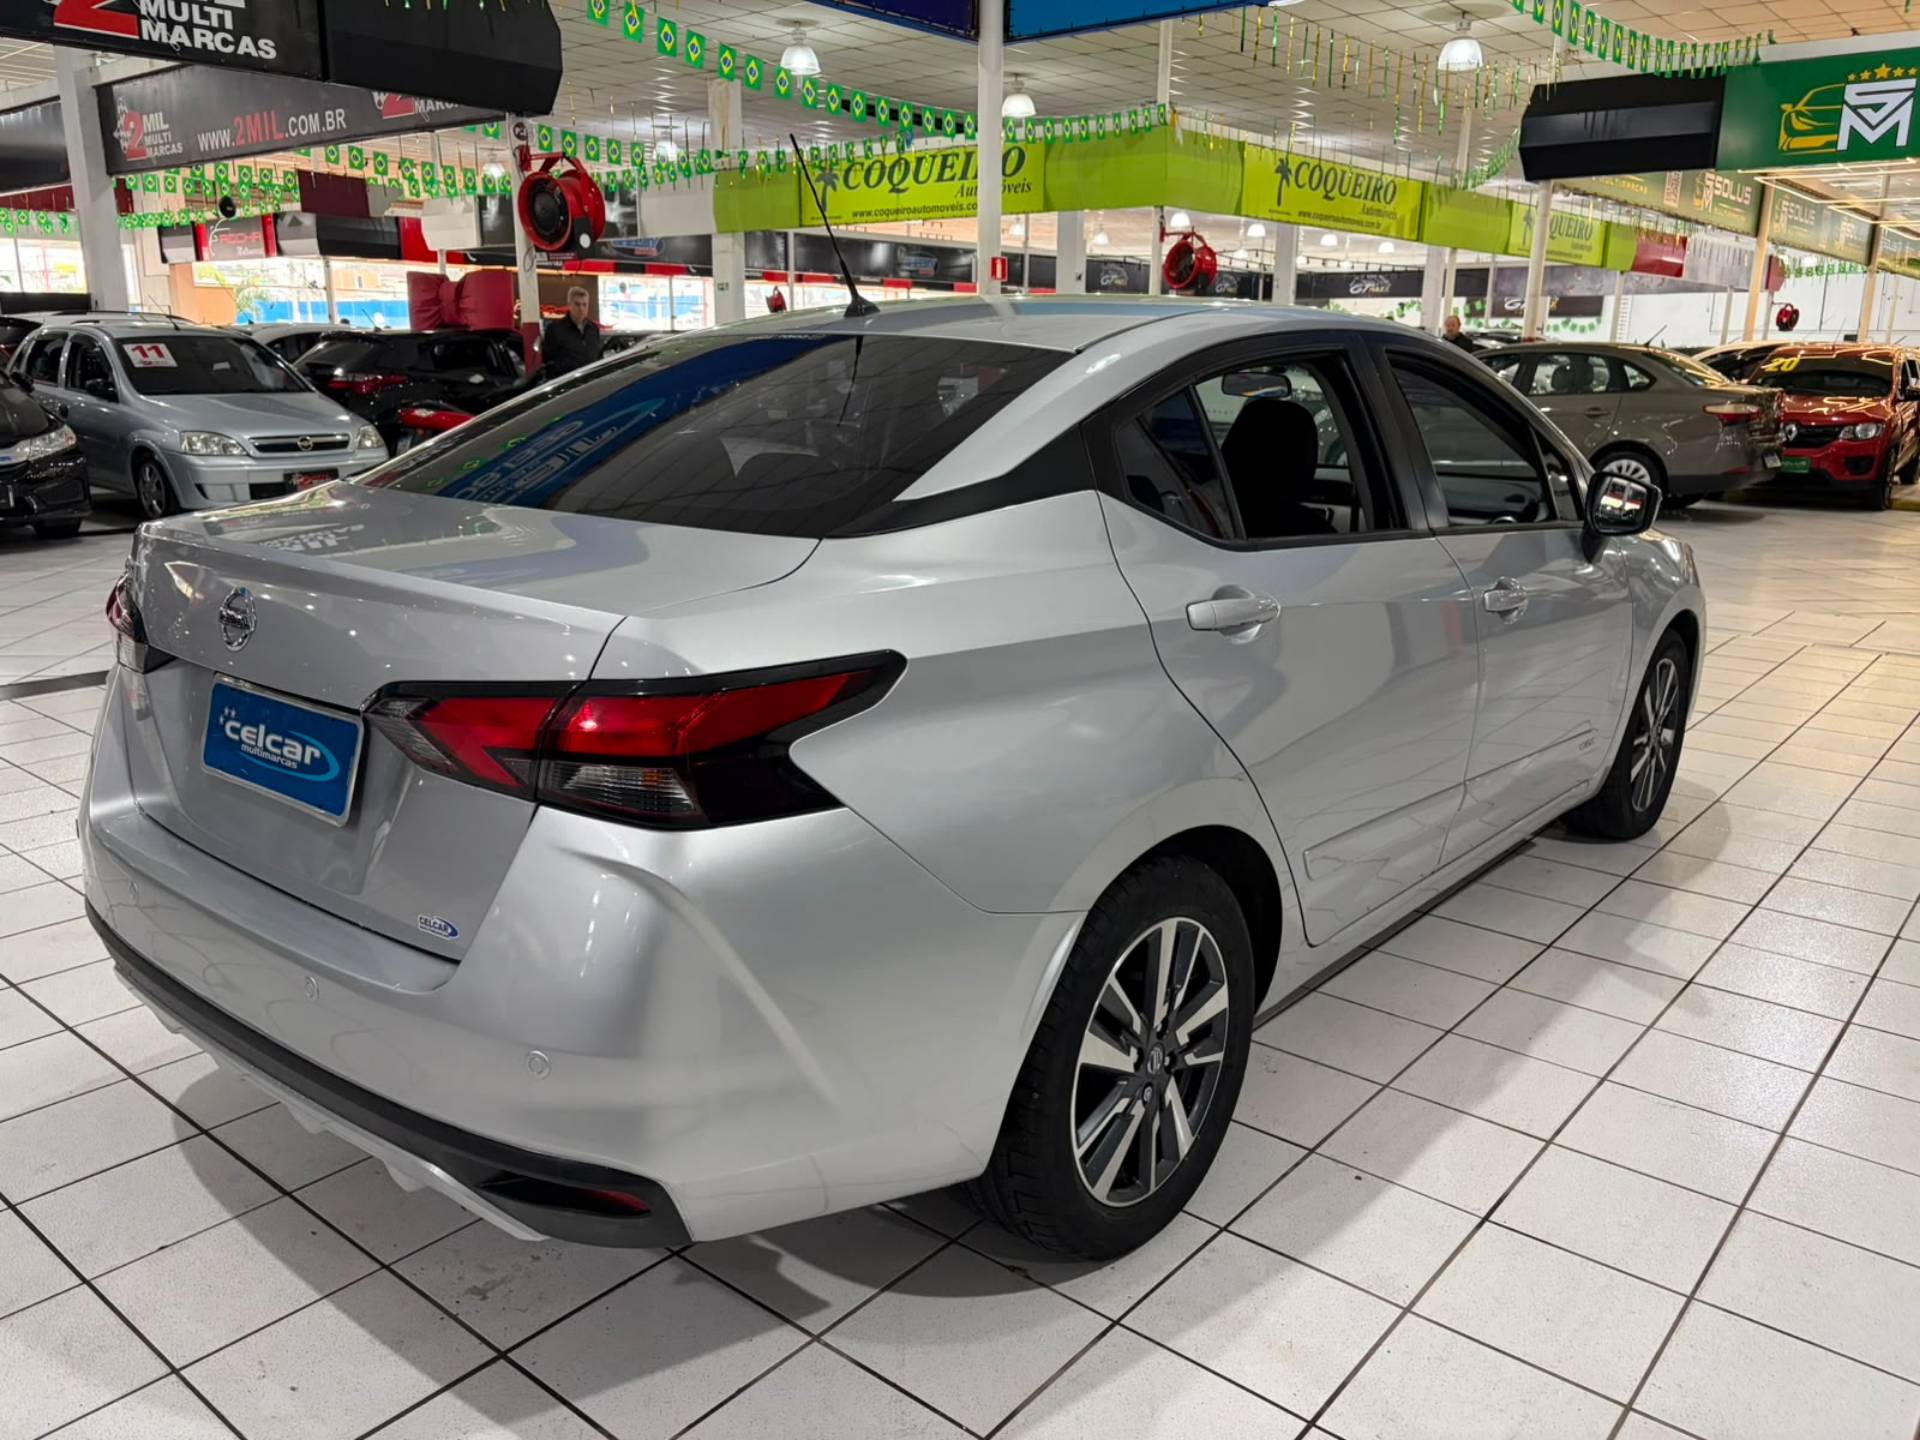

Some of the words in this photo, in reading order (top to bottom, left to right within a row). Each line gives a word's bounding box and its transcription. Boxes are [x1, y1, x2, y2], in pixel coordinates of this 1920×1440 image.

[139, 0, 233, 30] MULTI
[140, 19, 278, 60] MARCAS
[142, 112, 169, 133] MIL
[197, 108, 348, 152] WWW.2MIL.COM.BR
[144, 131, 172, 146] MULTI
[146, 142, 183, 158] MARCAS
[1295, 161, 1397, 205] COQUEIRO
[1714, 174, 1752, 206] SOLUS
[1549, 214, 1593, 241] QUEIRO
[132, 345, 165, 359] 11
[1762, 358, 1799, 372] 20
[224, 720, 321, 765] celcar
[240, 743, 298, 769] multimarcas
